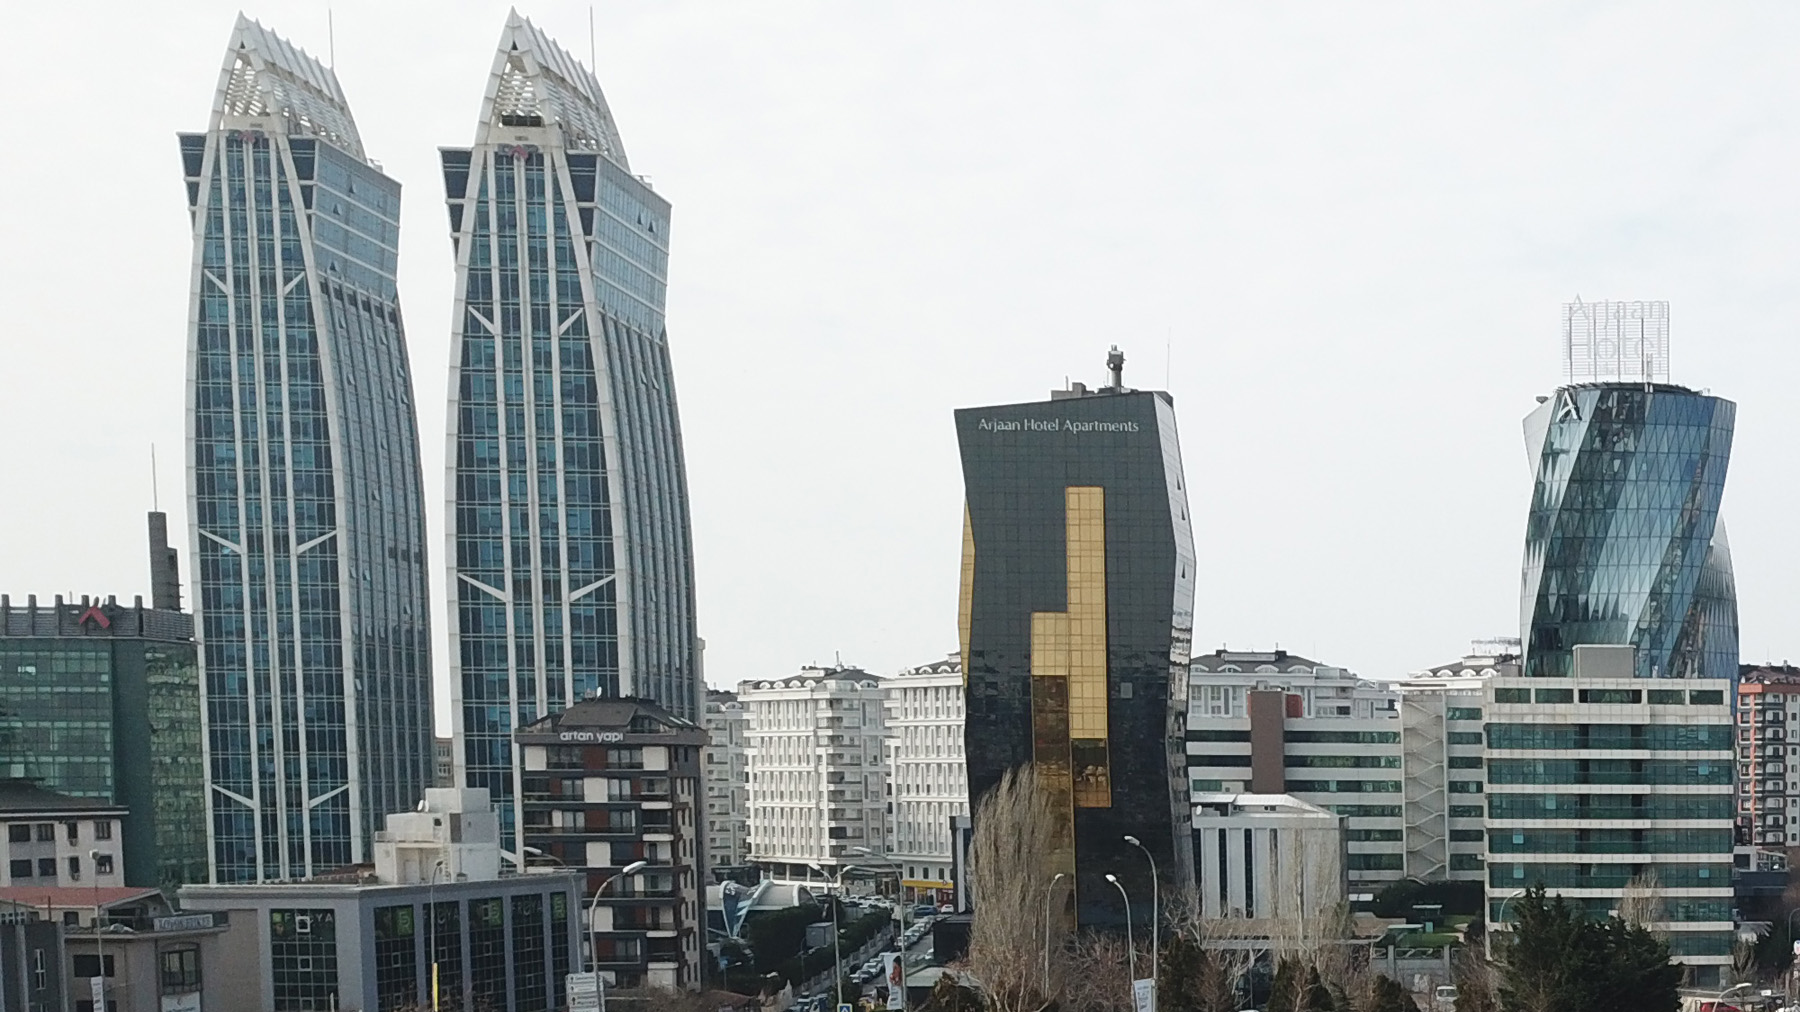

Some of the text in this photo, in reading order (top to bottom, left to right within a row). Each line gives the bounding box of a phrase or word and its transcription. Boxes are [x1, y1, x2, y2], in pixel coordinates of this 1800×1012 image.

[978, 418, 1140, 435] Arjaan Hotel Apartments
[559, 730, 594, 741] artan
